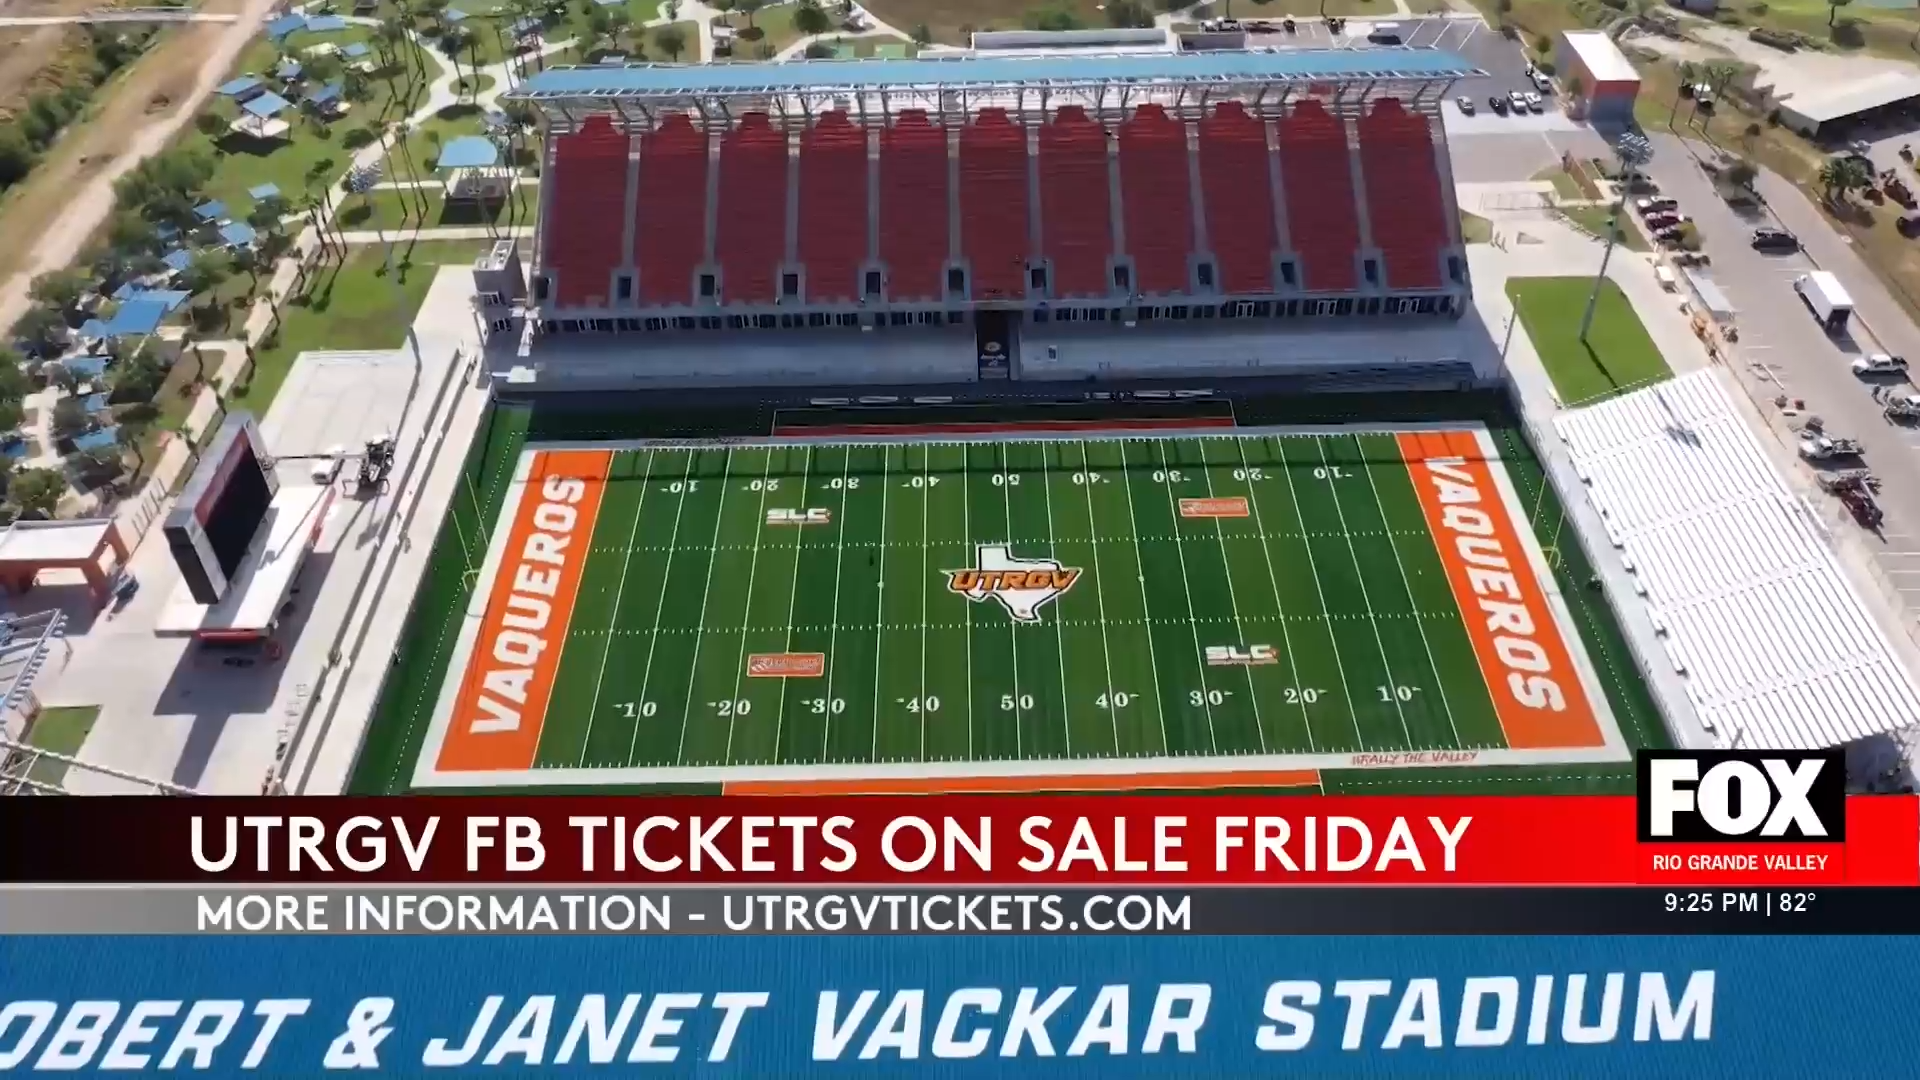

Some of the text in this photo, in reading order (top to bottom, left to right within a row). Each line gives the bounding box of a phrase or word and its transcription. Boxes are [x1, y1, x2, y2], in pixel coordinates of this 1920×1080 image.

[766, 508, 828, 521] SLC
[950, 570, 1080, 591] UTRGV
[1423, 456, 1567, 712] VAQUEROS
[468, 473, 586, 734] VAQUEROS
[1205, 645, 1273, 660] SLC
[1095, 692, 1129, 709] 40
[1190, 690, 1224, 706] 30
[1284, 687, 1317, 703] 20
[1377, 686, 1412, 702] 10
[623, 702, 657, 717] 10
[717, 699, 751, 716] 20
[811, 698, 845, 714] 30
[905, 696, 940, 712] 40
[1000, 695, 1034, 710] 50
[1432, 751, 1479, 762] VALLEY
[323, 997, 394, 1068] &
[423, 993, 769, 1066] JANET
[814, 985, 1211, 1060] VACKAR
[1256, 971, 1714, 1050] STADIUM
